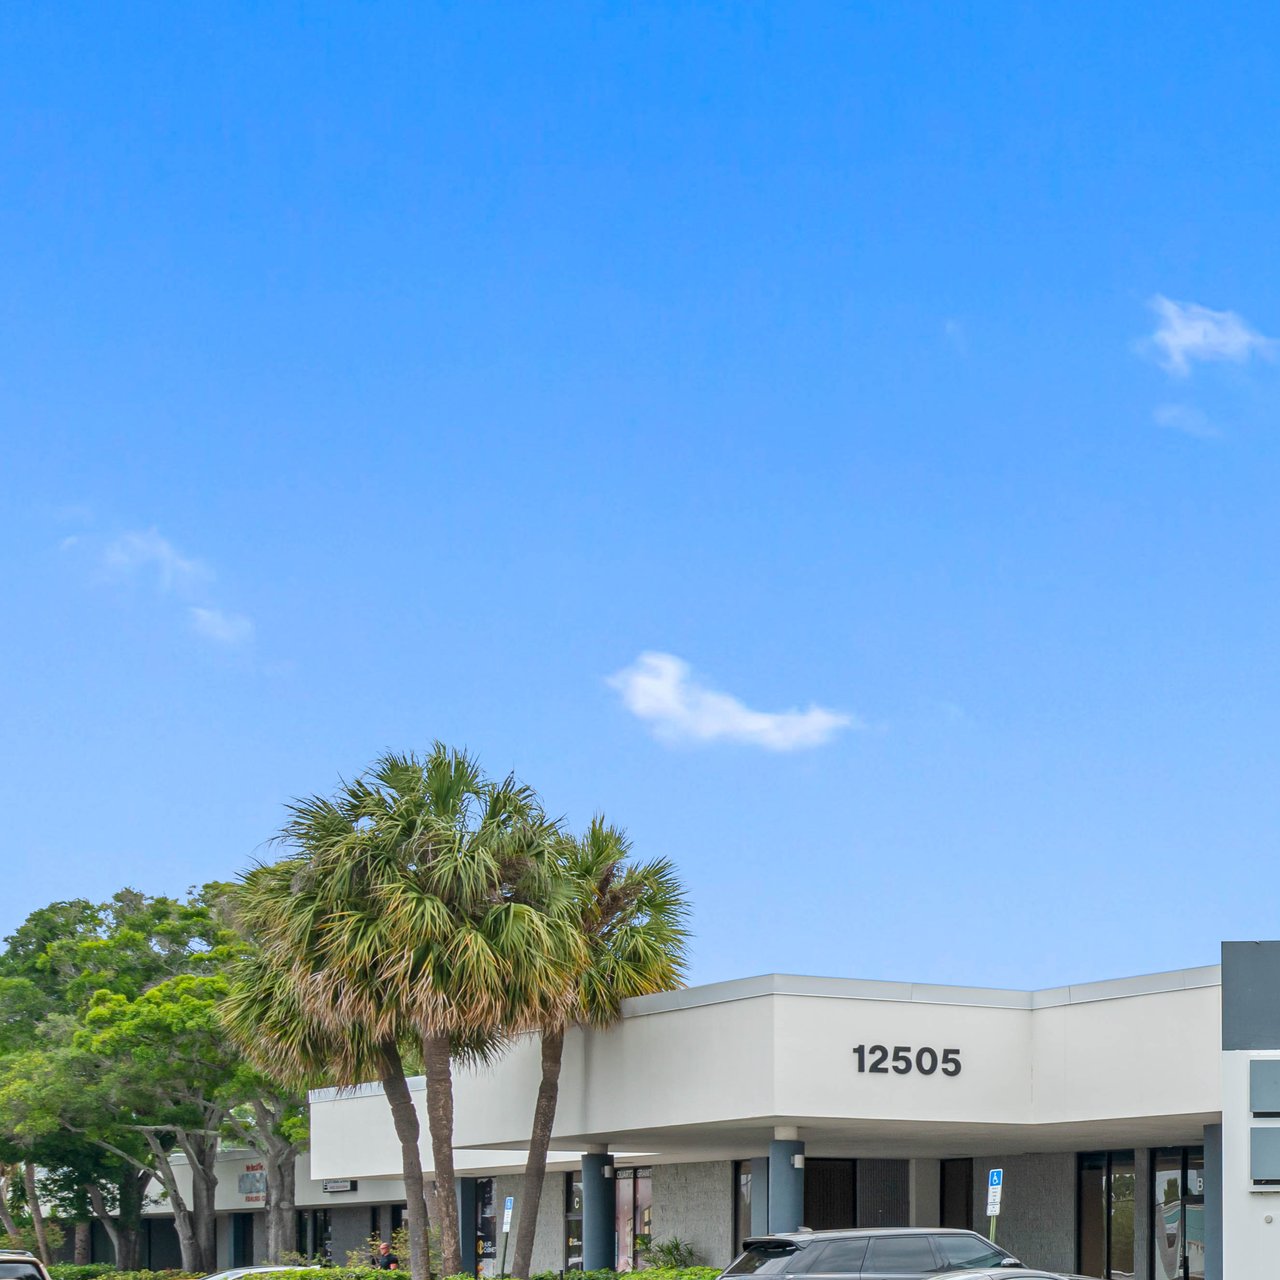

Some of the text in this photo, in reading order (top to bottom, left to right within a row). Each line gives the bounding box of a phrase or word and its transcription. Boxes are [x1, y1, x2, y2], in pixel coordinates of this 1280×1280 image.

[853, 1044, 962, 1076] 12505
[1197, 1178, 1204, 1190] B
[574, 1198, 580, 1209] C
